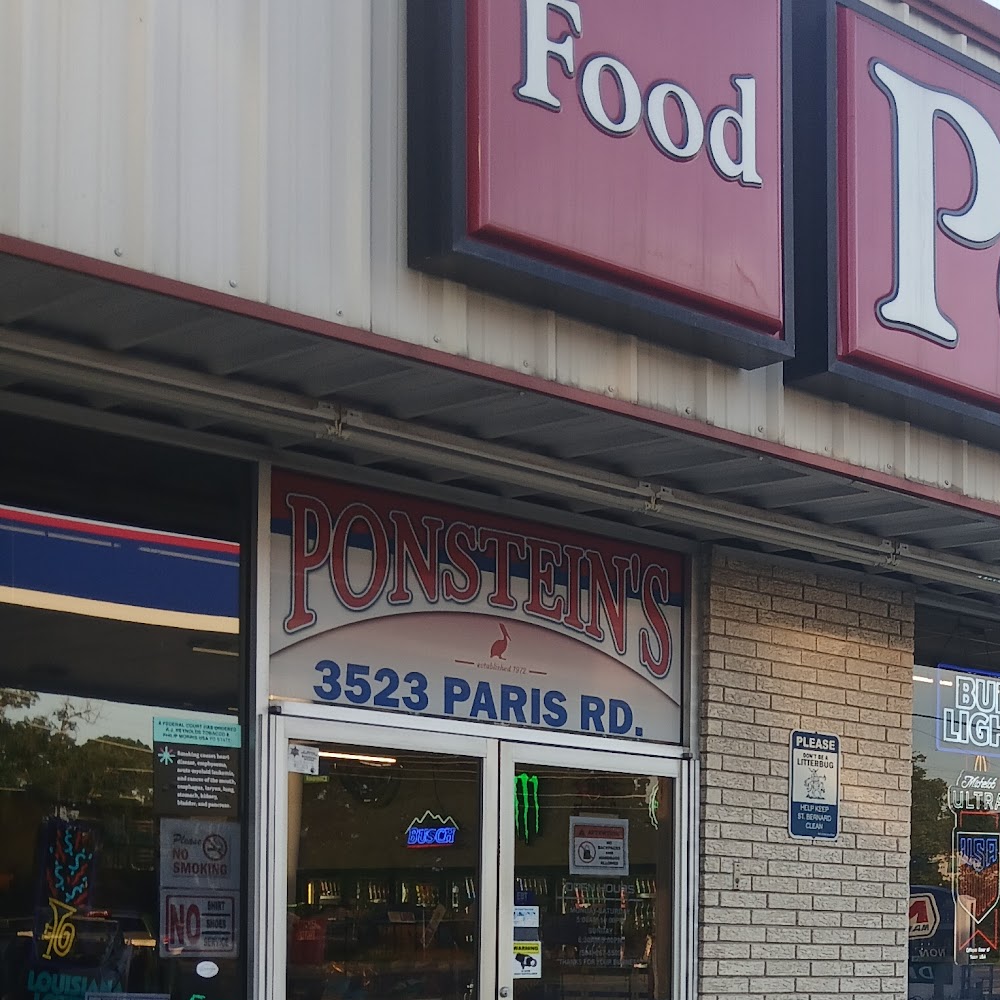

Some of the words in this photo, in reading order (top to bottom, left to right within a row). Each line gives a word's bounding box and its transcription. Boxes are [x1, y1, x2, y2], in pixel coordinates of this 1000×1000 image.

[513, 0, 764, 188] Food
[282, 493, 673, 680] PONSTEIN'S
[476, 661, 512, 673] established
[313, 659, 430, 711] 3523
[443, 676, 568, 728] PARIS
[580, 694, 643, 737] RD.
[796, 736, 836, 750] PLEASE
[797, 758, 834, 769] LITTERBUG
[800, 804, 815, 812] HELP
[806, 812, 832, 821] BERNARD
[805, 821, 823, 830] CLEAN
[408, 828, 457, 844] BUSCH
[172, 848, 189, 860] NO
[173, 862, 228, 875] SMOKING
[516, 892, 528, 900] EBT
[207, 901, 226, 911] SHIRT
[170, 903, 201, 945] NO
[206, 919, 227, 929] SHOES
